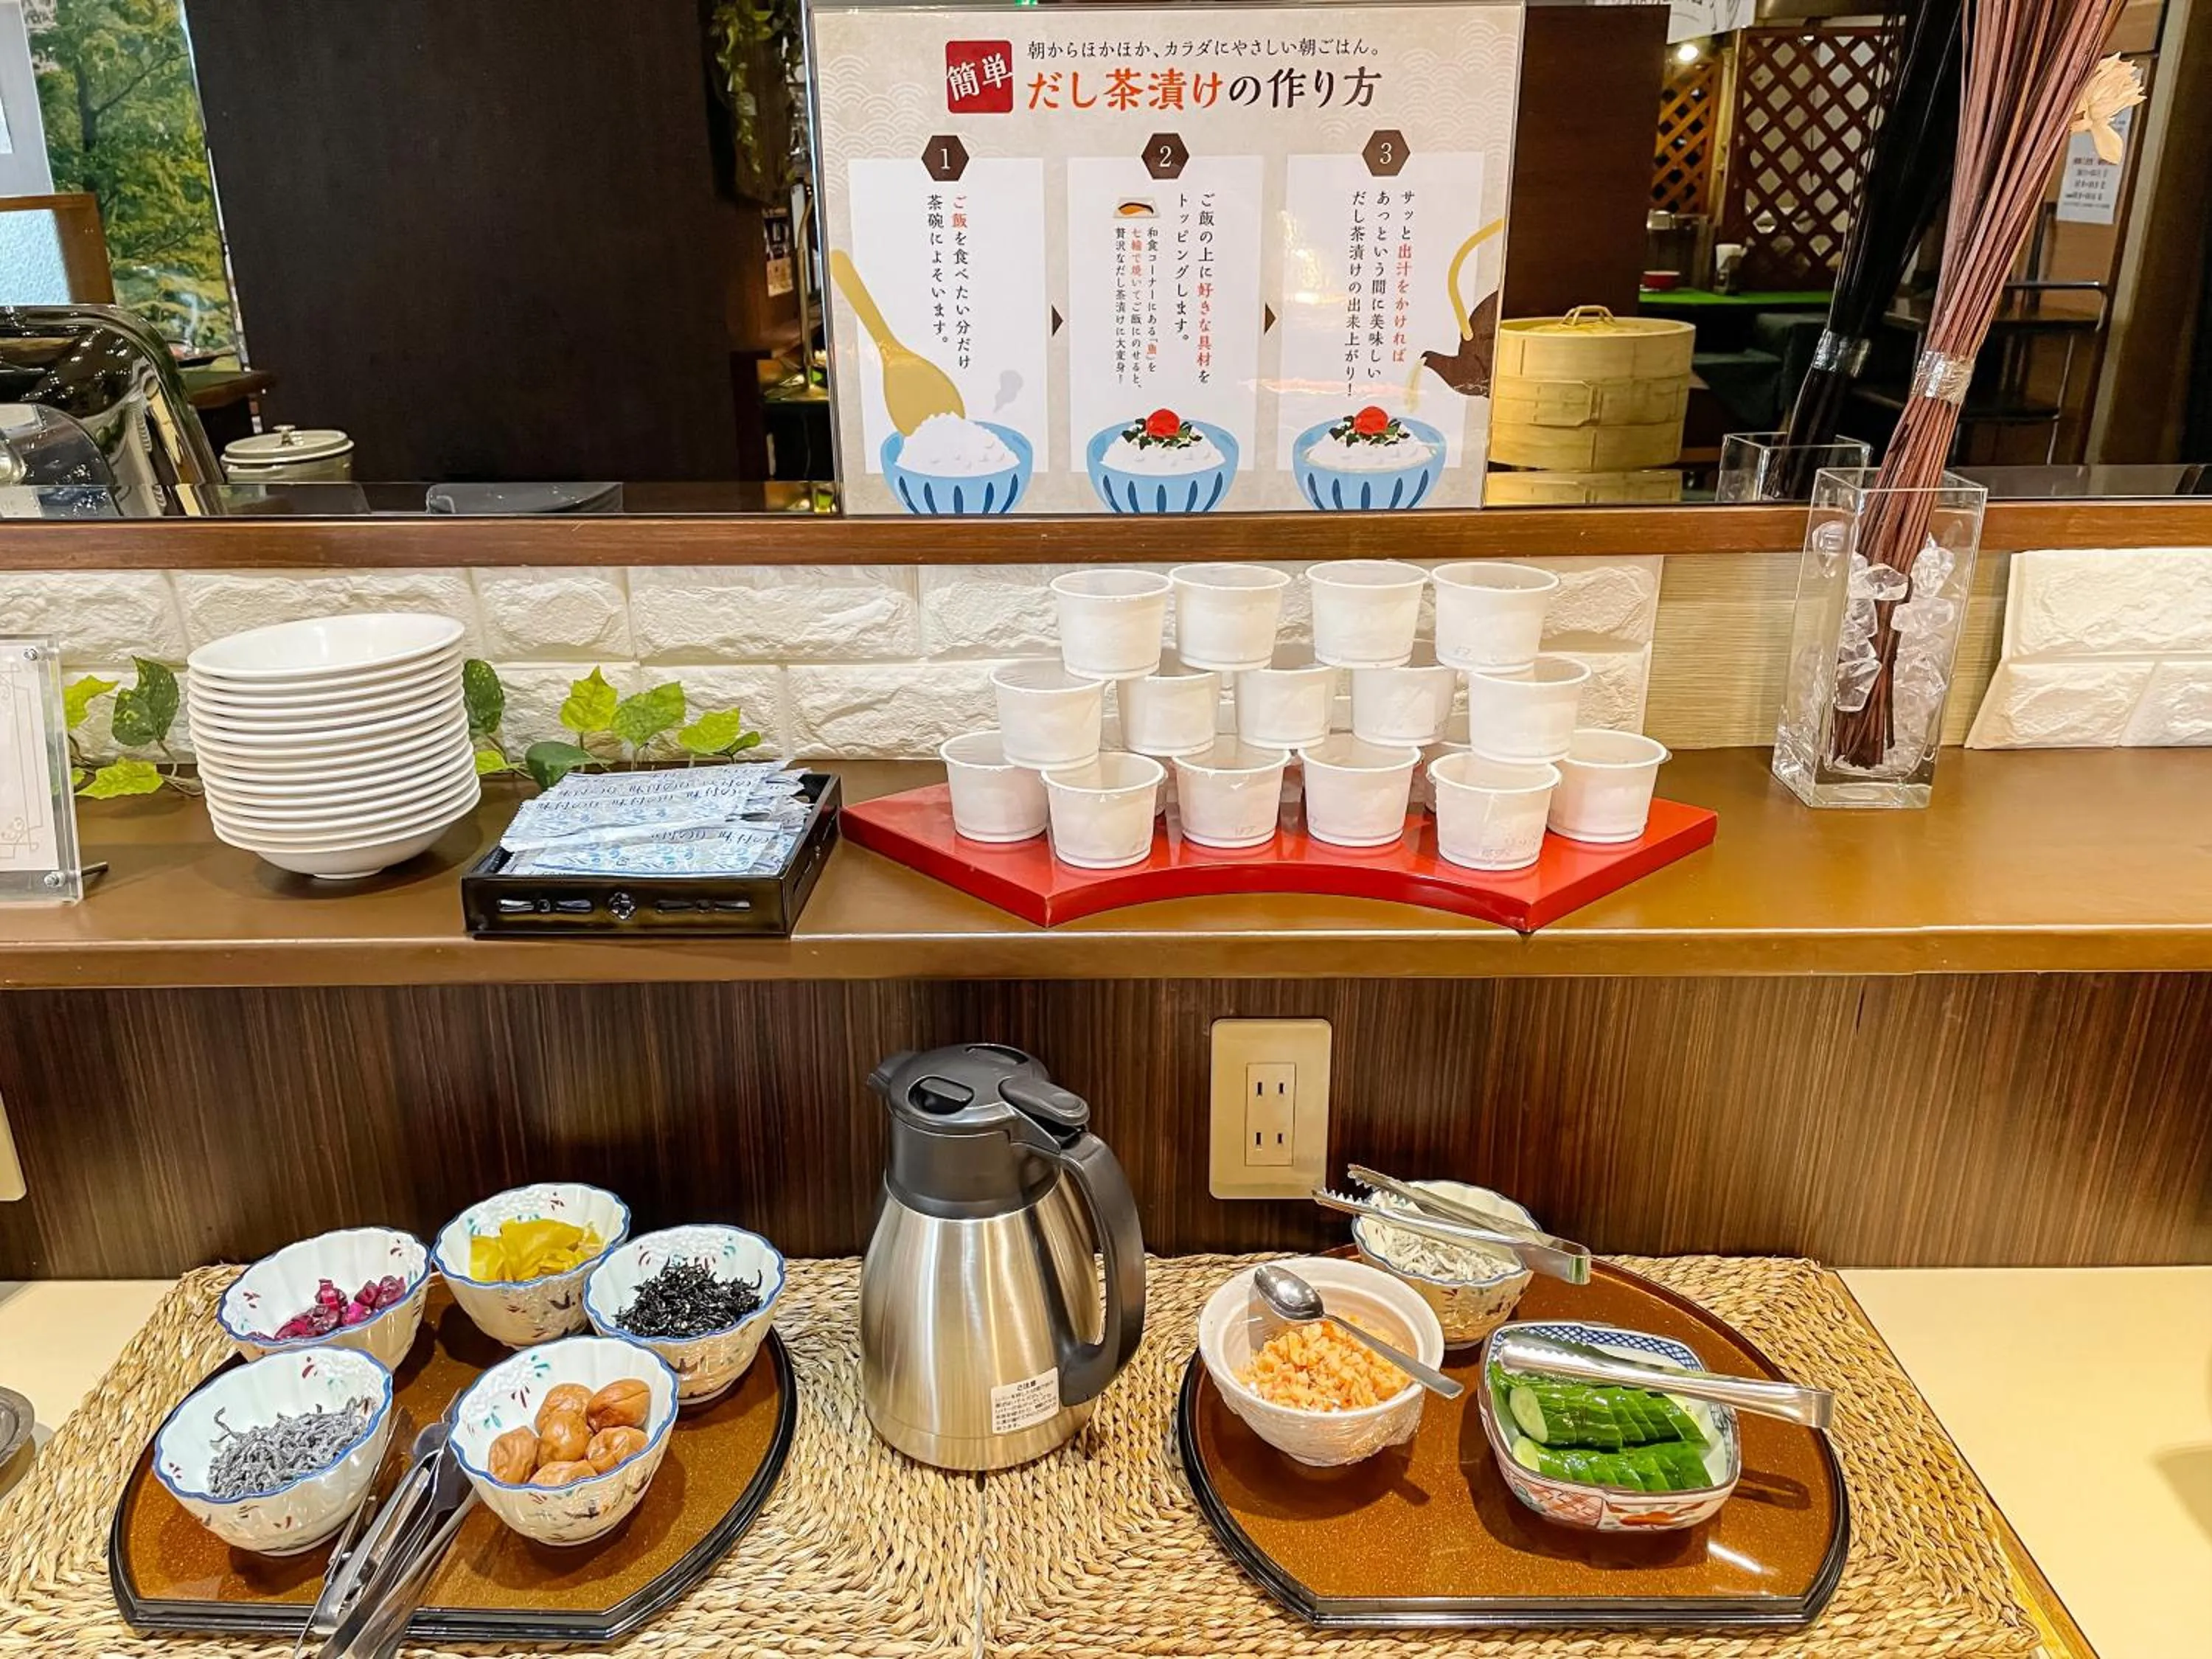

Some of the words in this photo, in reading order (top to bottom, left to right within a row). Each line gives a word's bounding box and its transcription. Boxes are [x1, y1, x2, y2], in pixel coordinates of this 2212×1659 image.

[947, 53, 1013, 101] 簡単
[1027, 38, 1380, 59] 朝からほかほか、カラダにやさしい朝ごはん。
[1027, 66, 1382, 111] だし茶漬けの作り方
[940, 148, 950, 170] 1
[1159, 145, 1172, 168] 2
[1380, 142, 1392, 165] 3
[928, 194, 948, 343] 茶碗によそいます。
[952, 195, 970, 369] ご飯を食べたい分だけ
[1175, 193, 1189, 340] トッピングします。
[1197, 192, 1215, 383] ご飯の上に好きな具材を
[1345, 191, 1366, 397] だし茶漬けの出来上がり！
[1368, 191, 1390, 378] あっという間に美味しい
[1392, 190, 1415, 362] サッと出汁をかければ
